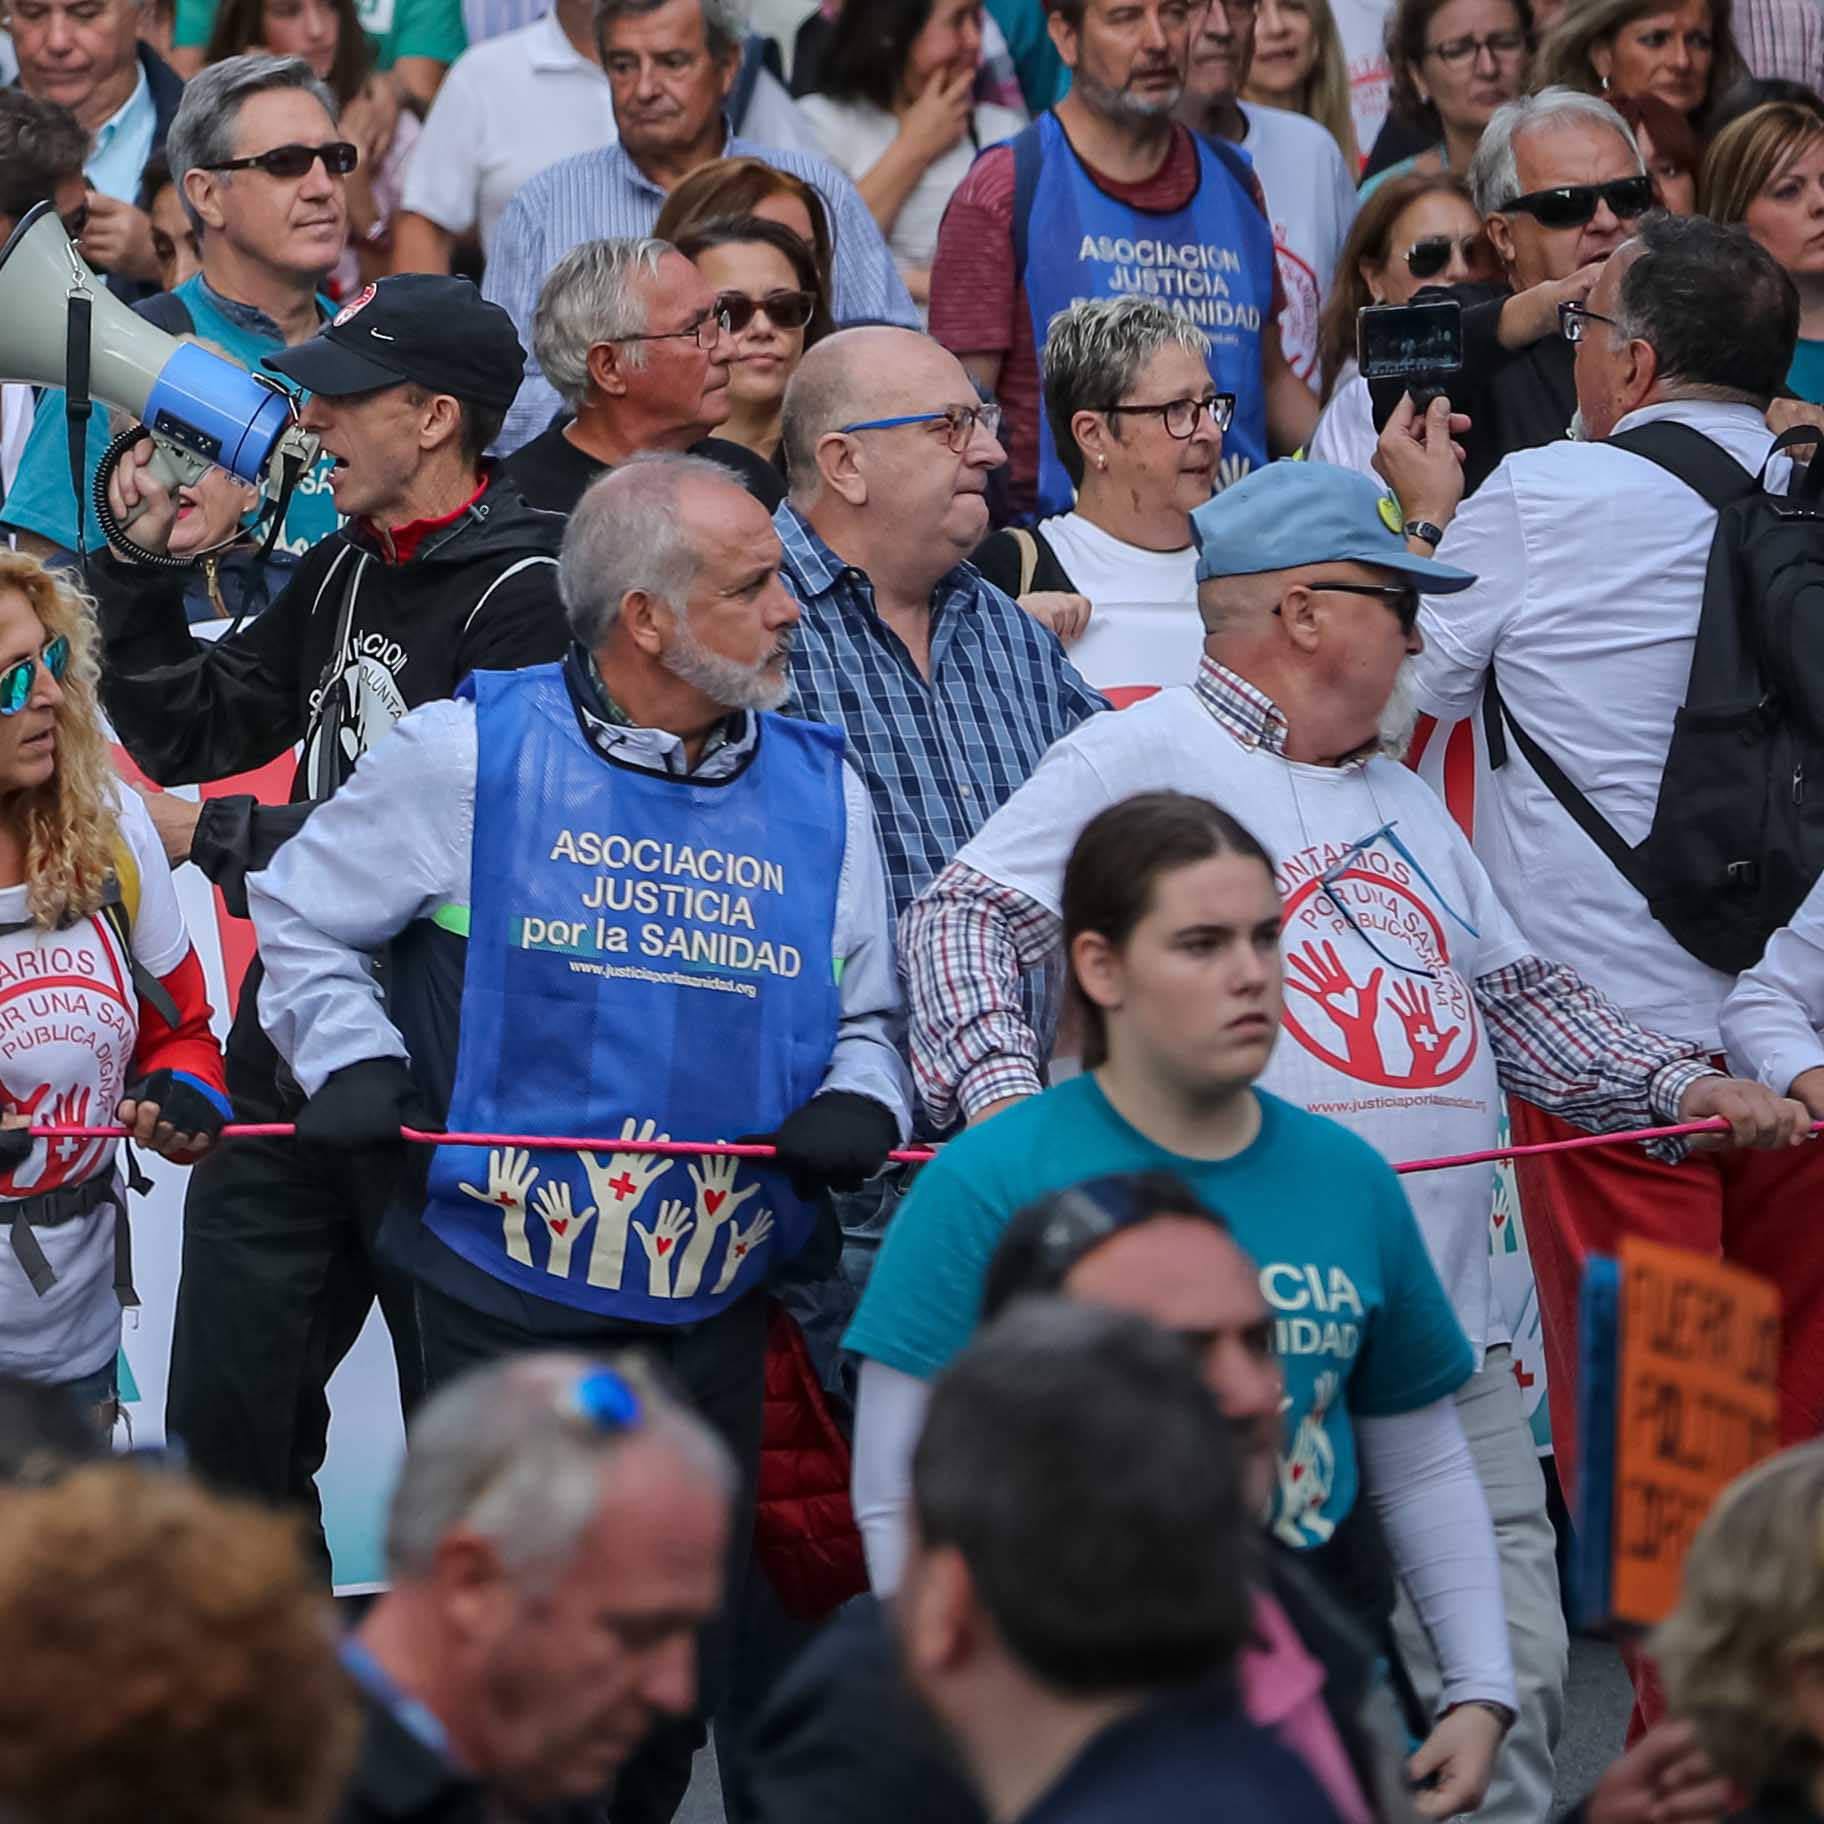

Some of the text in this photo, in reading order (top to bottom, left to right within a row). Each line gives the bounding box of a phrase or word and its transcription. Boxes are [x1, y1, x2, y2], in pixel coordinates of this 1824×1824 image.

[1079, 234, 1241, 273] ASOCIACION
[1108, 266, 1230, 298] JUSTICIA
[549, 828, 785, 896] ASOCIACION
[580, 875, 757, 930] JUSTICIA
[1299, 886, 1351, 931] POR
[520, 915, 803, 979] por la SANIDAD
[27, 992, 91, 1017] UNA
[1, 1023, 98, 1061] PÚBLICA
